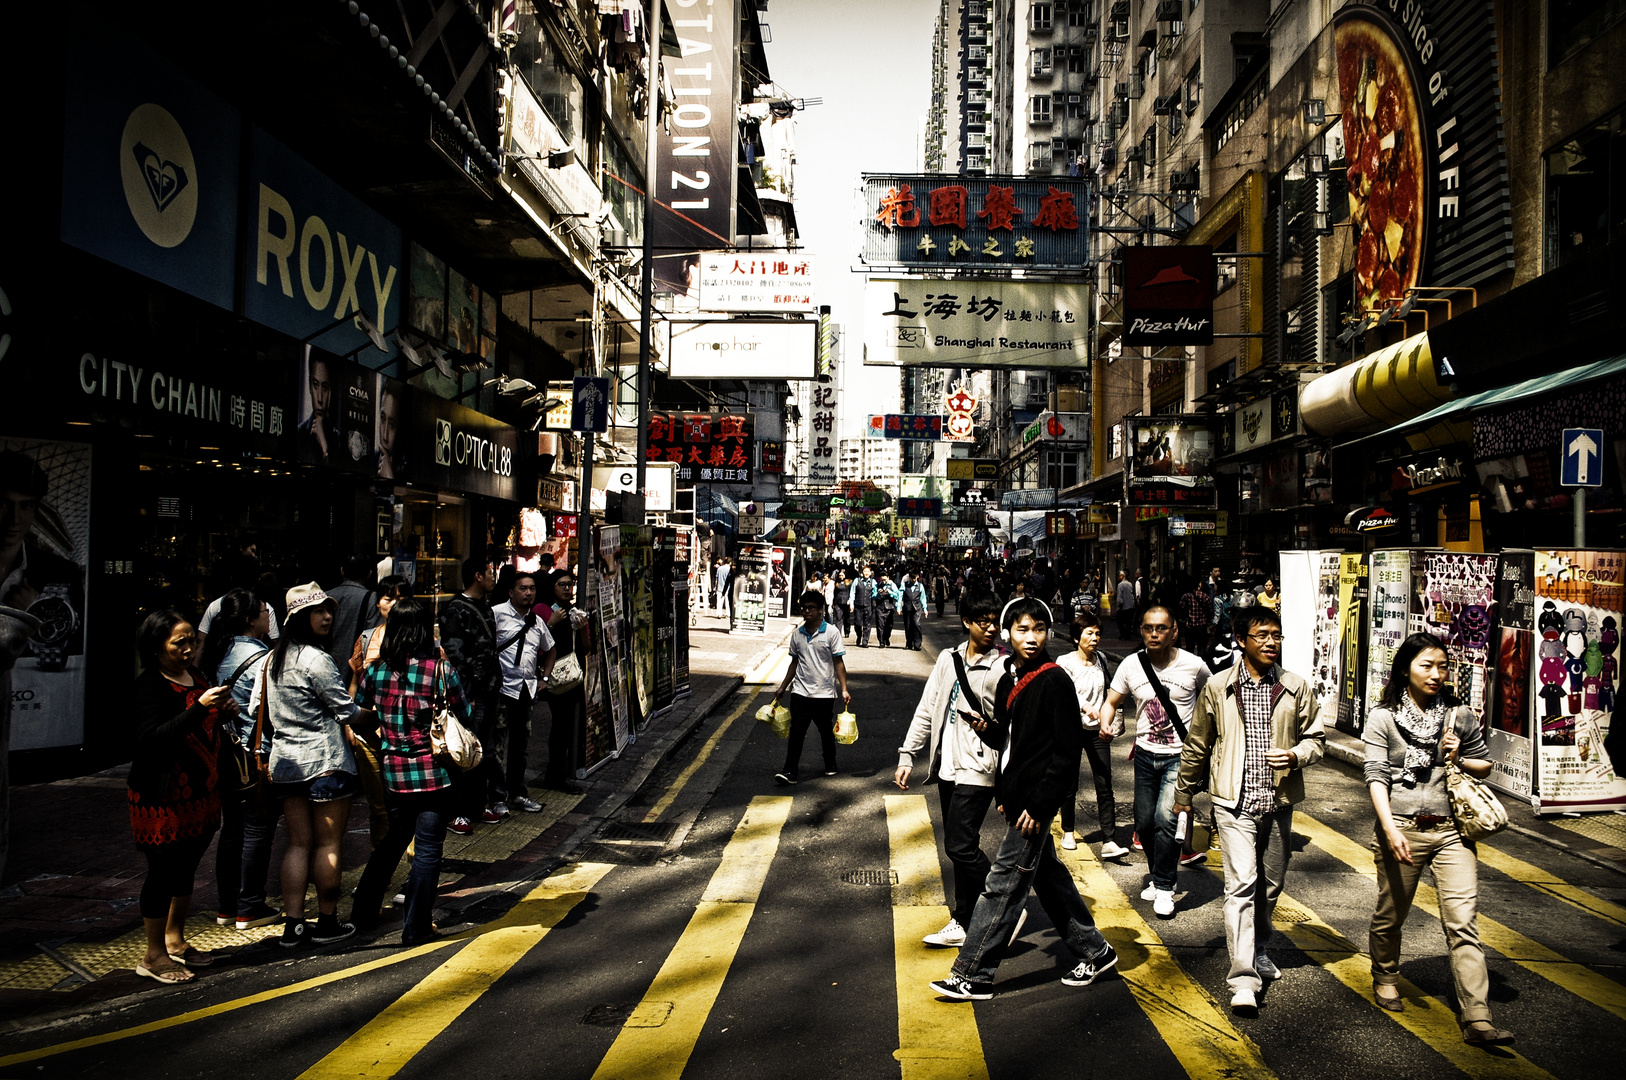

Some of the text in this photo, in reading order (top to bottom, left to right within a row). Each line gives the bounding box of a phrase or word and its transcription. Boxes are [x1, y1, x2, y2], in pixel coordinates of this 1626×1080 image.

[1402, 1, 1434, 65] slice
[1429, 69, 1450, 107] of
[1436, 116, 1460, 219] LIFE
[671, 170, 711, 210] 21
[875, 183, 1079, 231] 花園餐廳
[256, 182, 397, 336] ROXY
[916, 234, 1035, 257] 牛扒之家
[882, 291, 1076, 324] 上海坊 拉麵小籠包
[1129, 316, 1210, 334] Pizza Hut
[695, 335, 762, 357] map hair
[934, 335, 1073, 351] Shanghai Restaurant
[79, 352, 222, 423] CITY CHAIN
[349, 386, 369, 401] CYMA
[230, 394, 283, 437] 時間廊
[812, 358, 837, 458] 記甜品
[456, 431, 512, 477] OPTICAL 88
[620, 472, 633, 486] e
[1357, 518, 1383, 531] Pizza
[1428, 558, 1461, 578] Party
[1597, 558, 1623, 567] 潮流坊
[1384, 593, 1407, 604] iPhone 5
